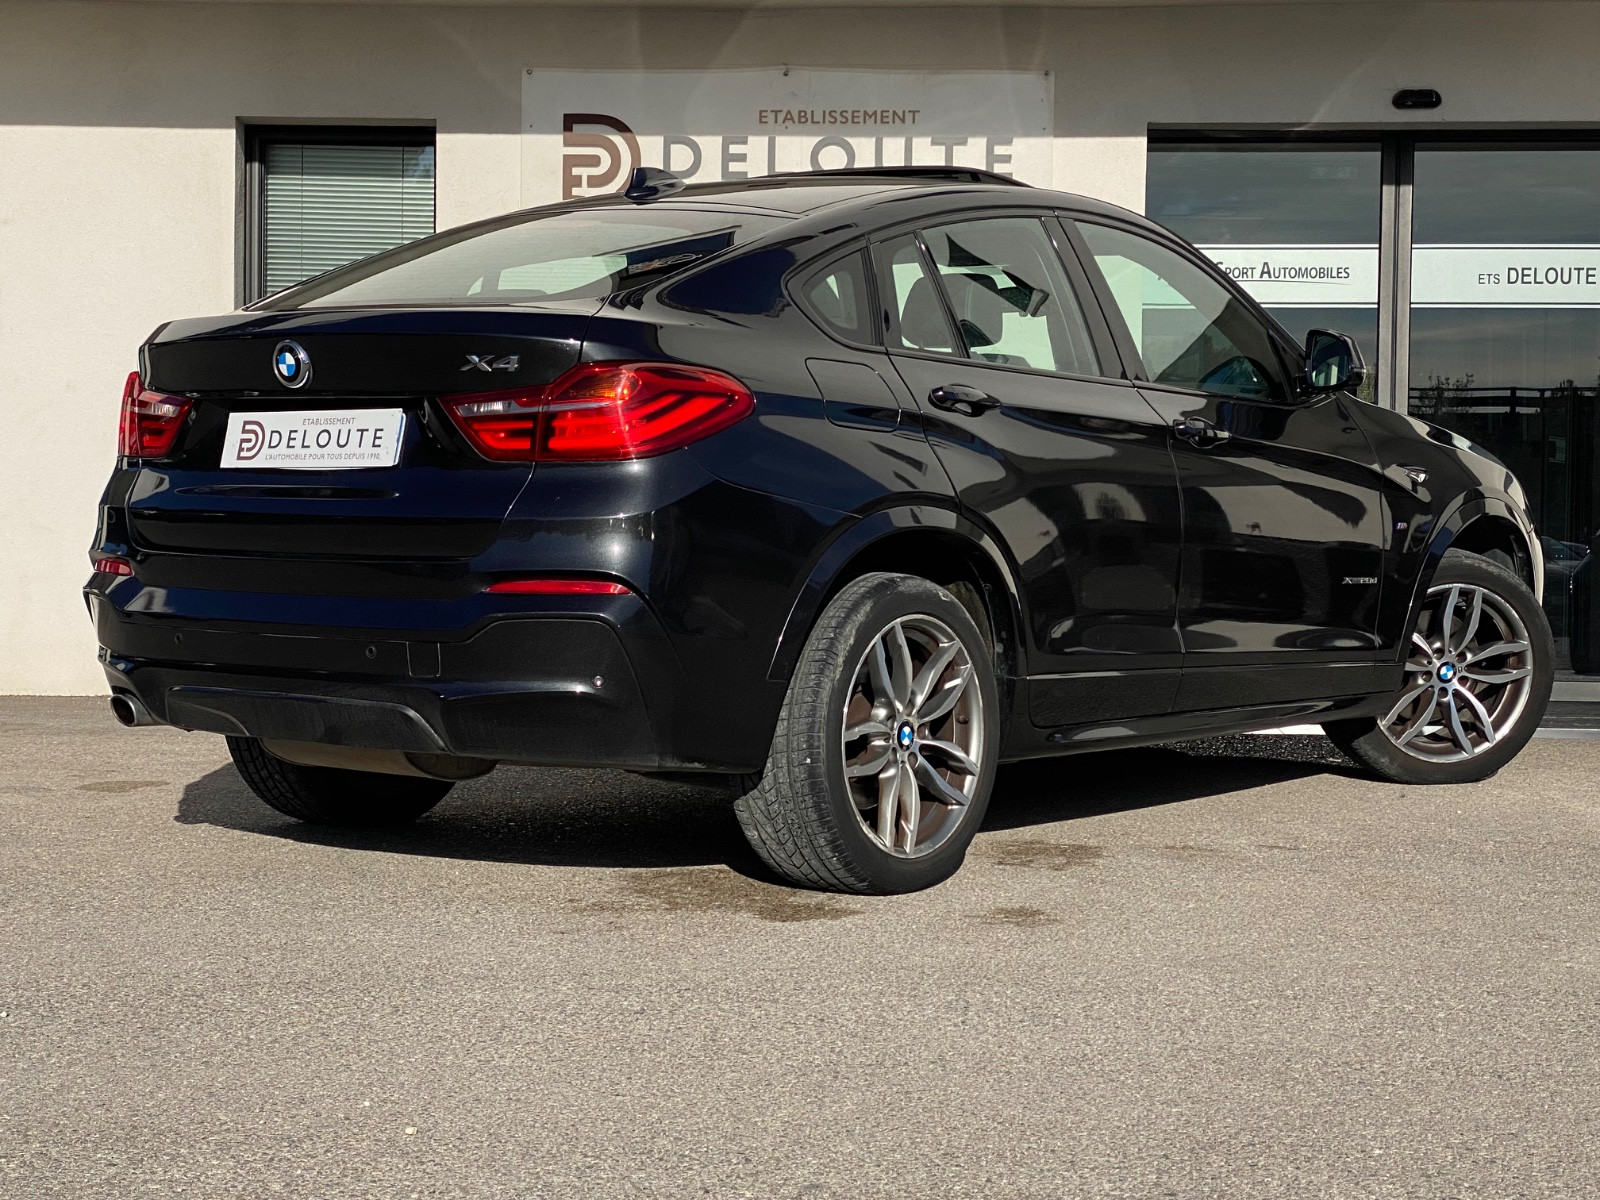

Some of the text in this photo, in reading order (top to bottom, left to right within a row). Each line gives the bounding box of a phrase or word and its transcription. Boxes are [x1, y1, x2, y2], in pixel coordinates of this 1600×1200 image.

[758, 109, 921, 125] ETABLISSEMENT
[662, 135, 1014, 181] DELOUTE
[1478, 267, 1597, 285] ETS DELOUTE
[459, 354, 521, 372] X4
[267, 428, 384, 449] DELOUTE
